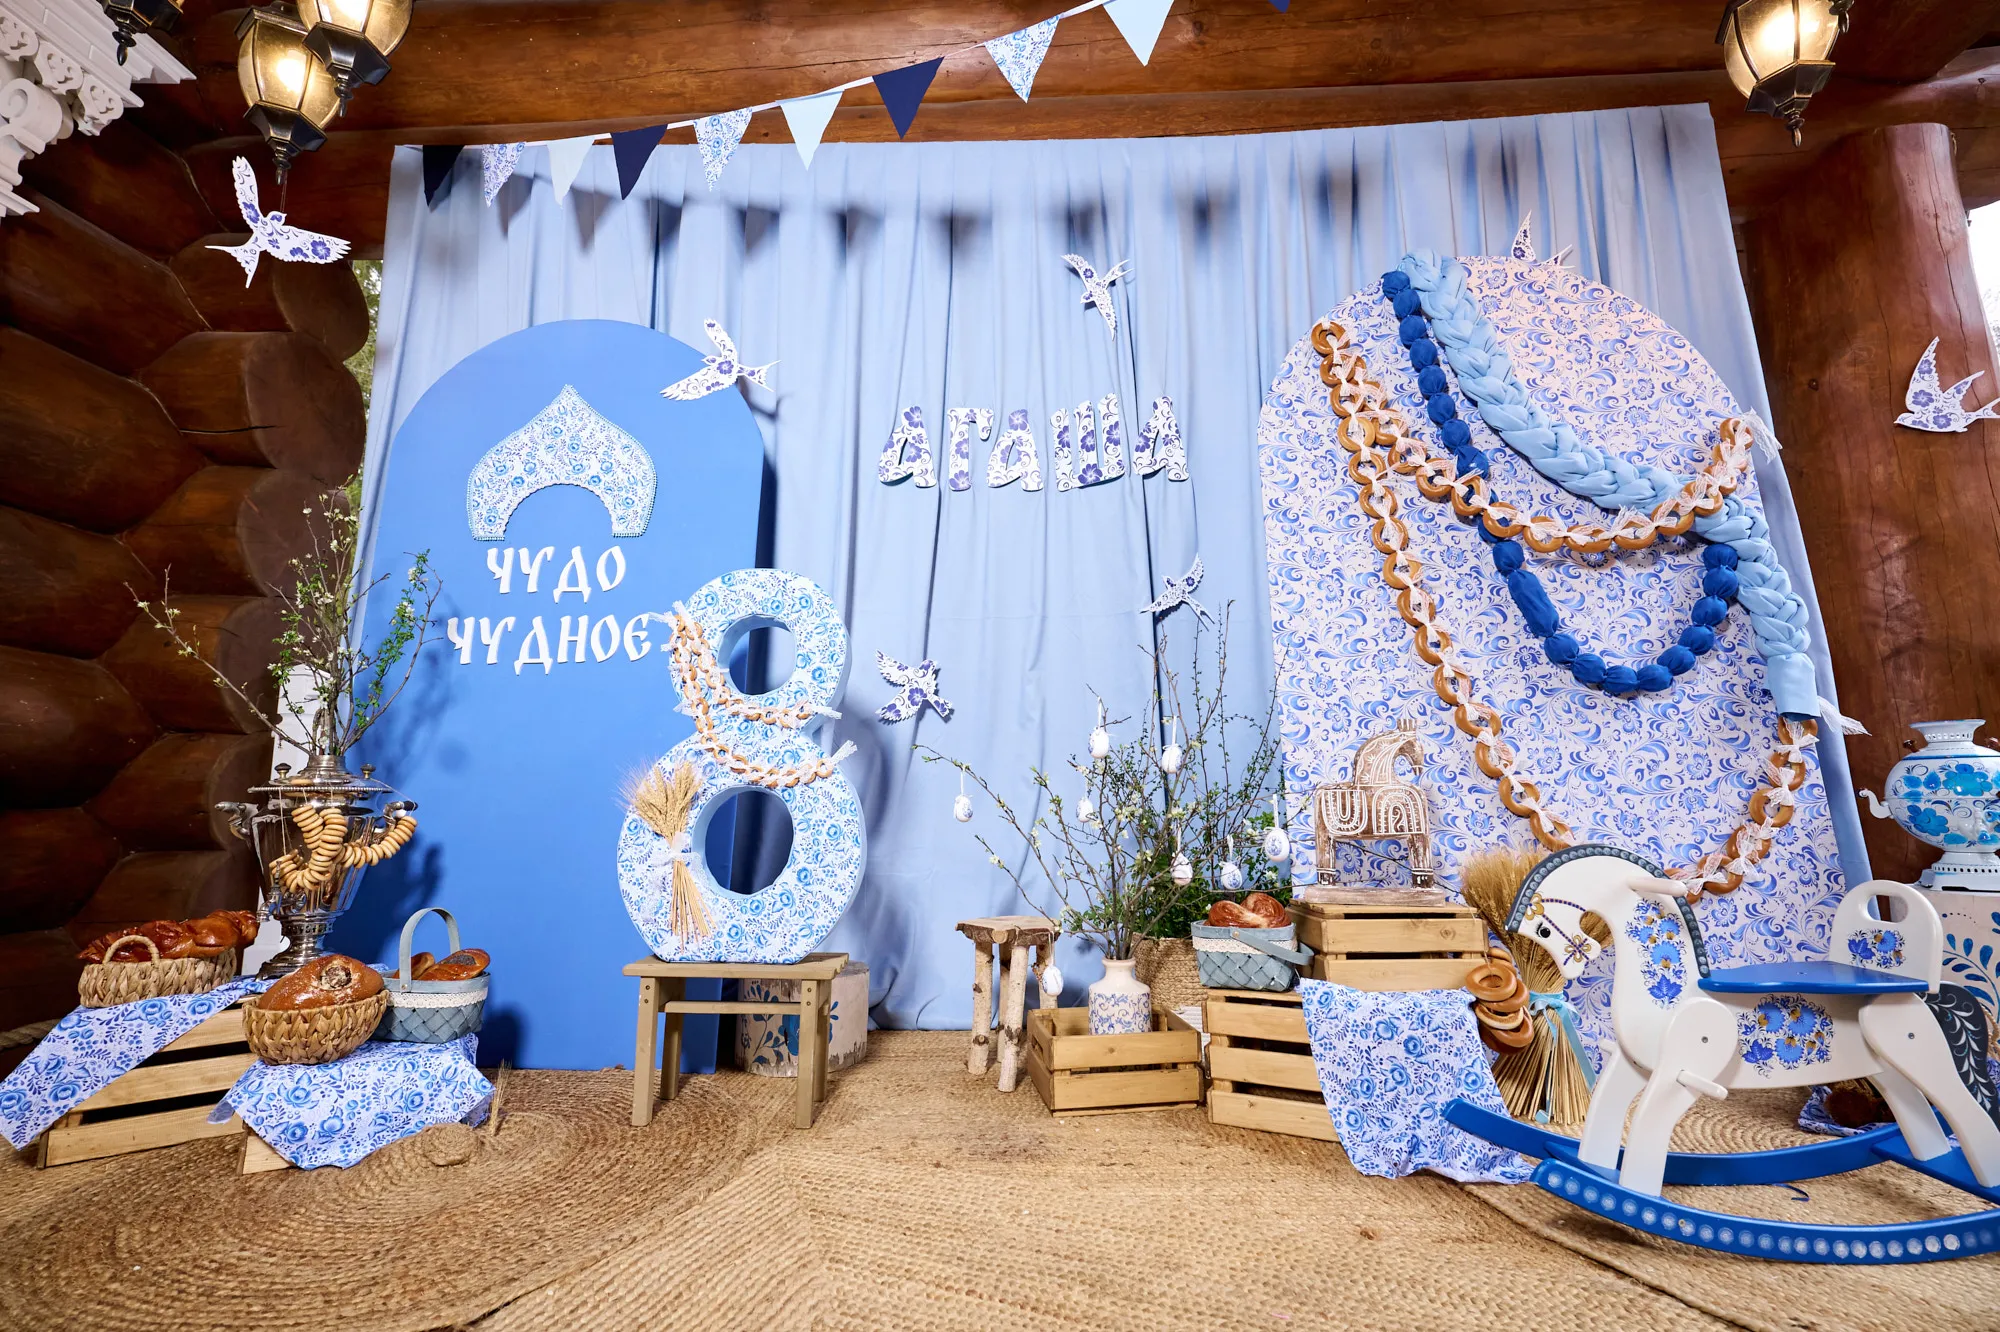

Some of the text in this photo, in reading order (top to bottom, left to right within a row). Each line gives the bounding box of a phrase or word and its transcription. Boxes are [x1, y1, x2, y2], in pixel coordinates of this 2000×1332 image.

[878, 392, 1190, 492] АГАША
[486, 545, 627, 604] ЧУДО
[447, 613, 652, 675] ЧУДНОЕ
[616, 567, 868, 965] 8
